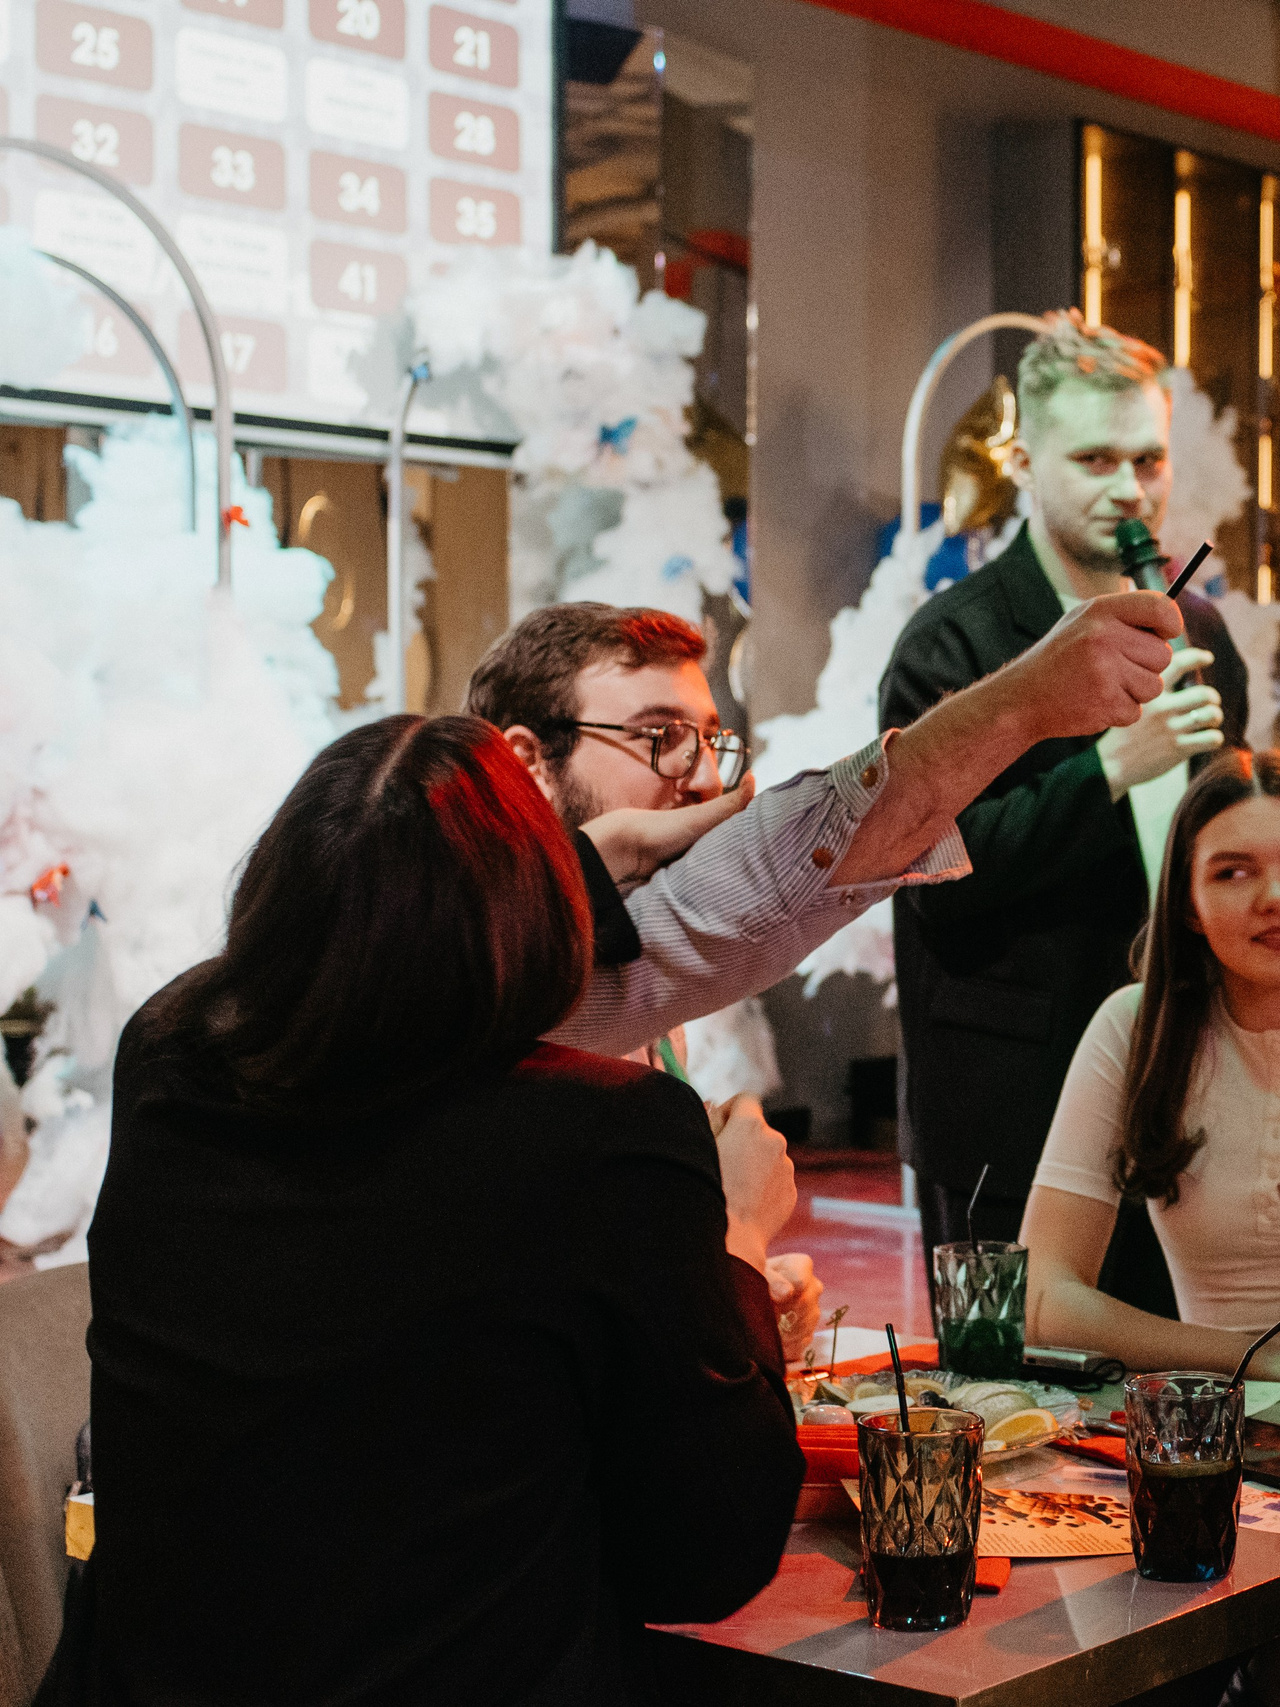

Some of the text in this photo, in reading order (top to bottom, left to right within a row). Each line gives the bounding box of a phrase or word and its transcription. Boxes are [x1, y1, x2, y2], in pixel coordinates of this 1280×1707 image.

[71, 22, 119, 70] 25
[453, 27, 490, 70] 21
[71, 119, 119, 167] 32
[454, 112, 496, 155] 28
[210, 146, 255, 191] 33
[338, 172, 380, 216] 34
[456, 197, 496, 238] 35
[338, 261, 377, 304] 41
